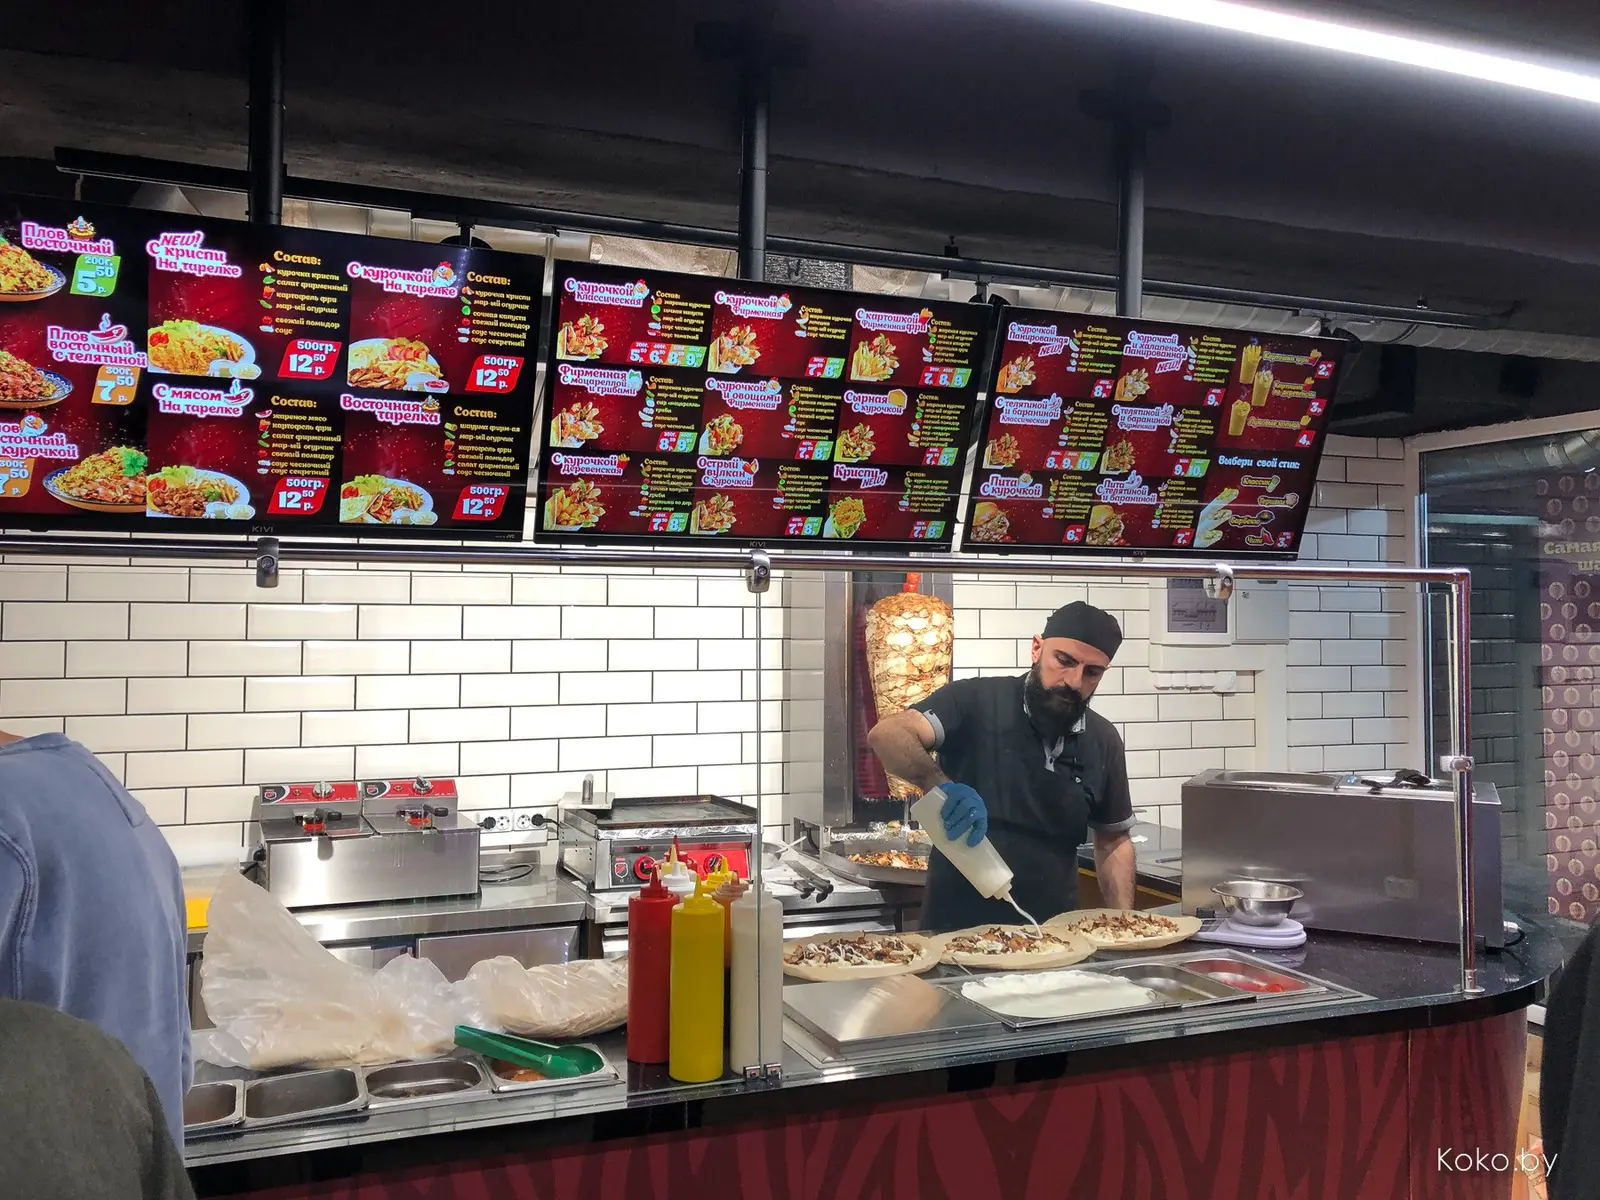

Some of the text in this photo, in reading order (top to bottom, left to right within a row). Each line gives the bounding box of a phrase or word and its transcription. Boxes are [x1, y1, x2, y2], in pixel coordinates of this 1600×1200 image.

[24, 224, 65, 240] Плов
[25, 237, 111, 254] восточный
[161, 233, 201, 247] NEW!
[149, 242, 224, 261] С криспи
[273, 250, 321, 265] Состав:
[85, 256, 113, 266] 200г.
[159, 257, 239, 275] На тарелке
[77, 270, 97, 293] 5
[96, 266, 114, 277] 50
[277, 269, 311, 278] курочка
[350, 263, 432, 283] С курочкой
[467, 271, 511, 285] Состав:
[301, 281, 348, 292] фирменный
[385, 280, 457, 297] На тарелке
[567, 280, 633, 296] С курочкой
[276, 291, 337, 304] картофель фри
[577, 292, 641, 306] Классическая
[716, 293, 777, 308] С курочкой
[732, 306, 782, 318] Фирменная
[857, 310, 919, 323] С картошкой
[306, 319, 340, 329] помидор
[907, 323, 926, 333] фри
[1017, 325, 1056, 335] курочкой
[50, 328, 89, 341] Плов
[275, 327, 293, 335] соус
[1137, 335, 1177, 343] курочкой
[50, 341, 132, 354] восточный
[297, 341, 337, 355] 500гр.
[1040, 344, 1061, 356] NEW!
[55, 351, 146, 366] с телятиной
[289, 354, 312, 373] 12
[484, 356, 519, 370] 500гр.
[560, 365, 627, 379] Фирменная
[1158, 360, 1181, 372] NEW!
[476, 368, 498, 387] 12
[498, 368, 509, 376] 50
[571, 377, 627, 388] моцареллой
[97, 377, 135, 401] 7 50
[597, 387, 636, 395] грибами
[707, 379, 767, 393] С курочкой
[155, 386, 221, 401] С мясом
[732, 394, 780, 402] овощами
[845, 391, 888, 404] Сырная
[163, 400, 240, 415] На тарелке
[271, 395, 317, 408] Состав:
[342, 395, 420, 412] Восточная
[728, 399, 776, 409] Фирменная
[997, 399, 1048, 409] С телятиной
[454, 406, 498, 419] Состав:
[861, 404, 902, 414] курочкой
[1013, 408, 1059, 417] бараниной
[1113, 406, 1160, 416] С телятиной
[377, 411, 438, 424] тарелка
[0, 425, 20, 433] ов
[272, 423, 314, 431] картофель
[295, 434, 341, 442] фирменный
[2, 446, 76, 457] курочкой
[271, 460, 288, 469] соус
[553, 454, 617, 467] С курочкой
[698, 458, 739, 470] Острый
[1219, 455, 1252, 468] Выбери
[1257, 458, 1277, 467] свой
[10, 469, 28, 478] 50
[562, 464, 622, 474] Деревенская
[707, 469, 745, 479] вулкан
[835, 465, 879, 479] Криспи
[286, 478, 324, 491] 500гр.
[711, 477, 752, 486] курочкой
[862, 473, 887, 487] NEW!
[990, 476, 1017, 486] Пита
[1104, 480, 1125, 489] Пита
[470, 486, 505, 497] 500гр.
[981, 485, 1041, 497] С курочкой
[1105, 487, 1147, 496] телятиной
[278, 491, 301, 508] 12
[302, 490, 314, 498] 50
[1110, 494, 1156, 504] бараниной
[462, 498, 484, 515] 12
[252, 525, 274, 533] KIVI
